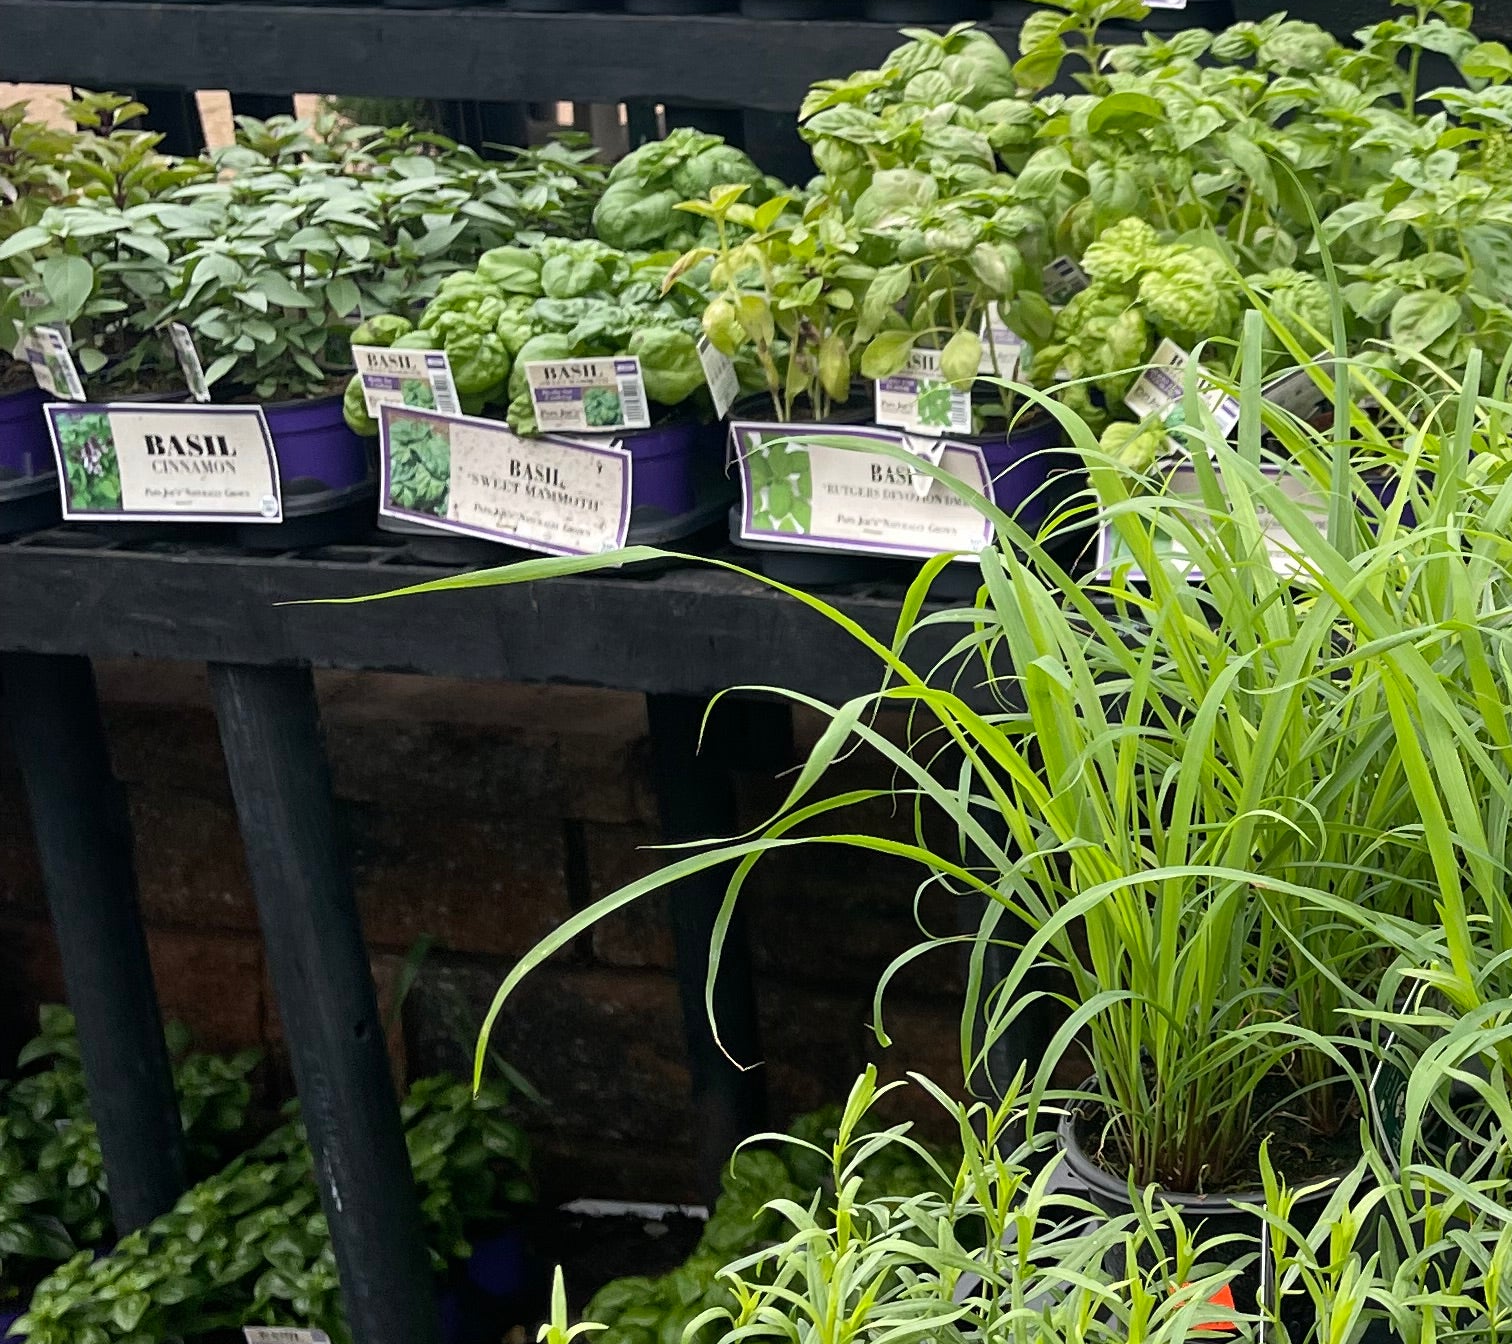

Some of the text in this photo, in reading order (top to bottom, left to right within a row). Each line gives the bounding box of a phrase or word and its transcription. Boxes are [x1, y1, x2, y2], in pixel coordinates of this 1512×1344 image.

[367, 353, 417, 370] BASIL
[543, 364, 604, 380] BASIL
[144, 435, 237, 457] BASIL
[151, 459, 237, 474] CINNAMON
[509, 459, 566, 490] BASIL
